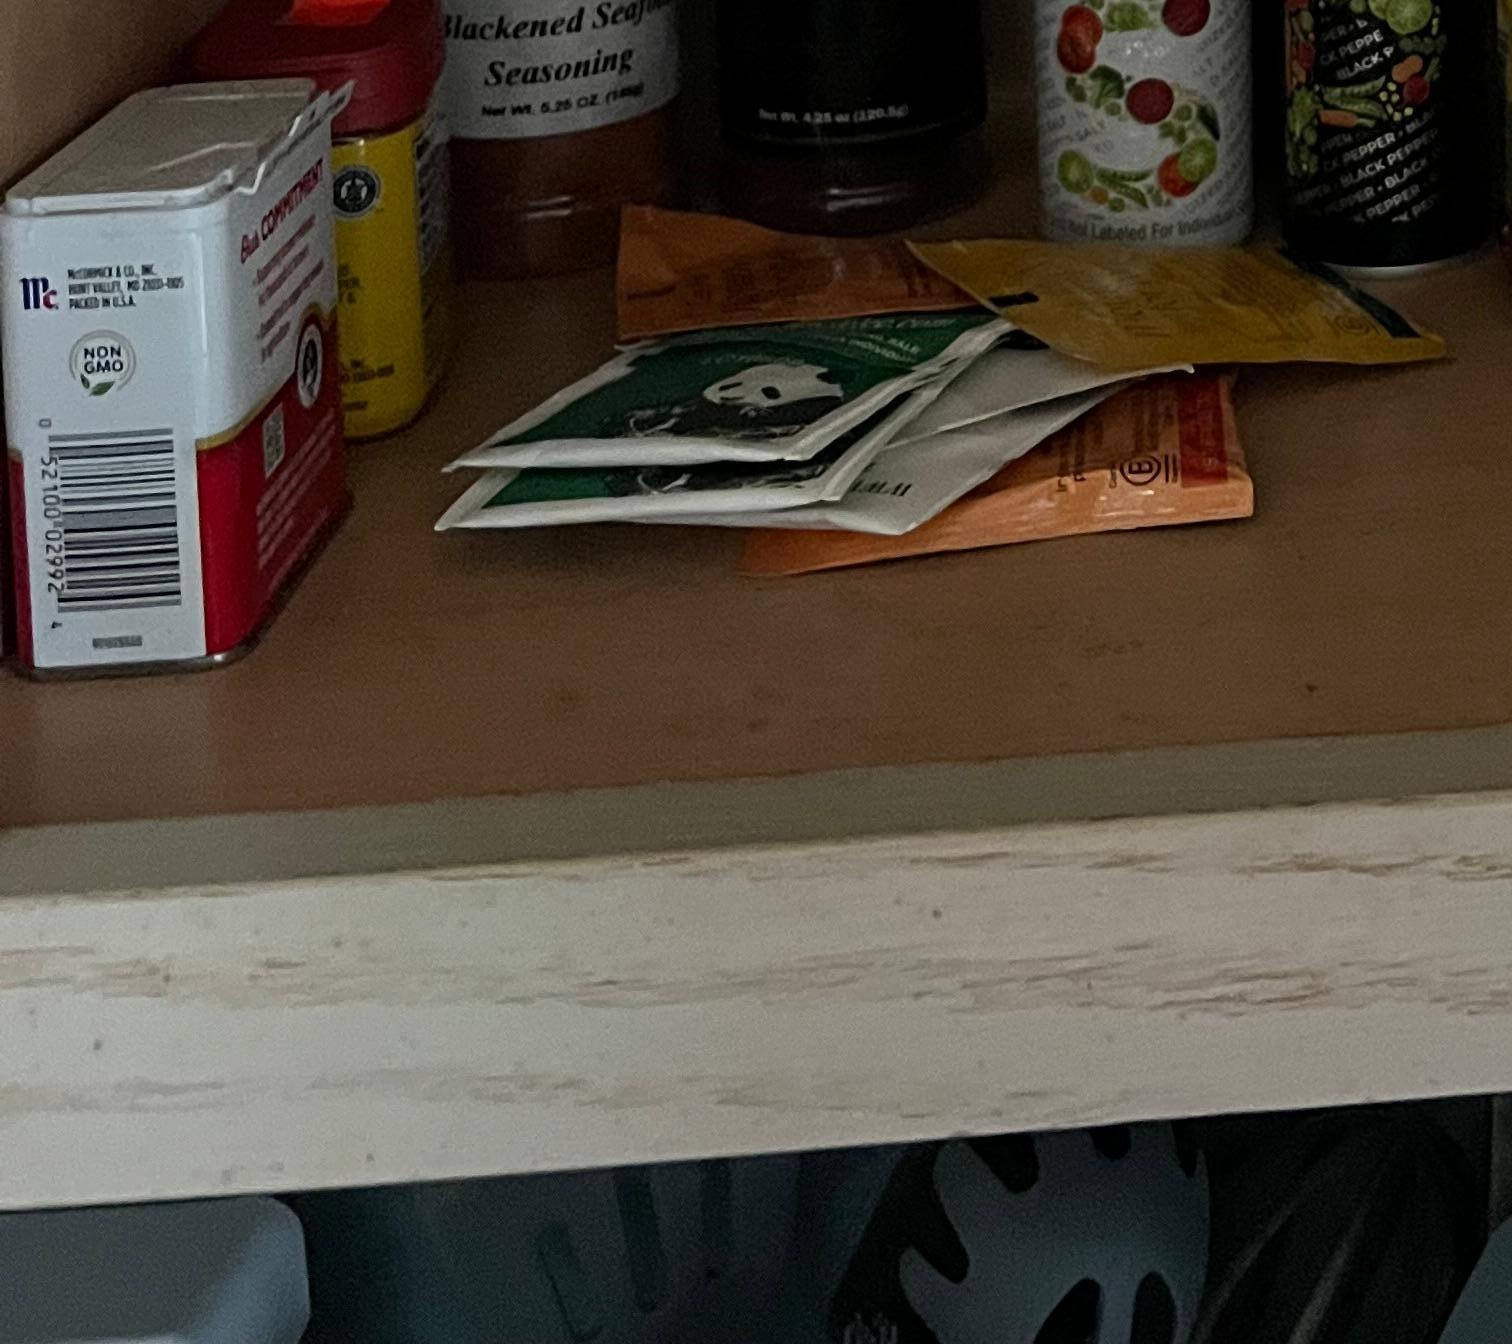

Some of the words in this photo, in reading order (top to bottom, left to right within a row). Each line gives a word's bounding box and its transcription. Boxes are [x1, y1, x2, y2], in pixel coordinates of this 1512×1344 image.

[483, 48, 635, 88] Seasoning
[1342, 131, 1397, 164] PEPPER
[1340, 157, 1387, 189] BLACK
[84, 346, 121, 359] NON
[84, 360, 123, 374] GMO
[40, 455, 61, 523] 52100
[45, 527, 64, 596] 02992
